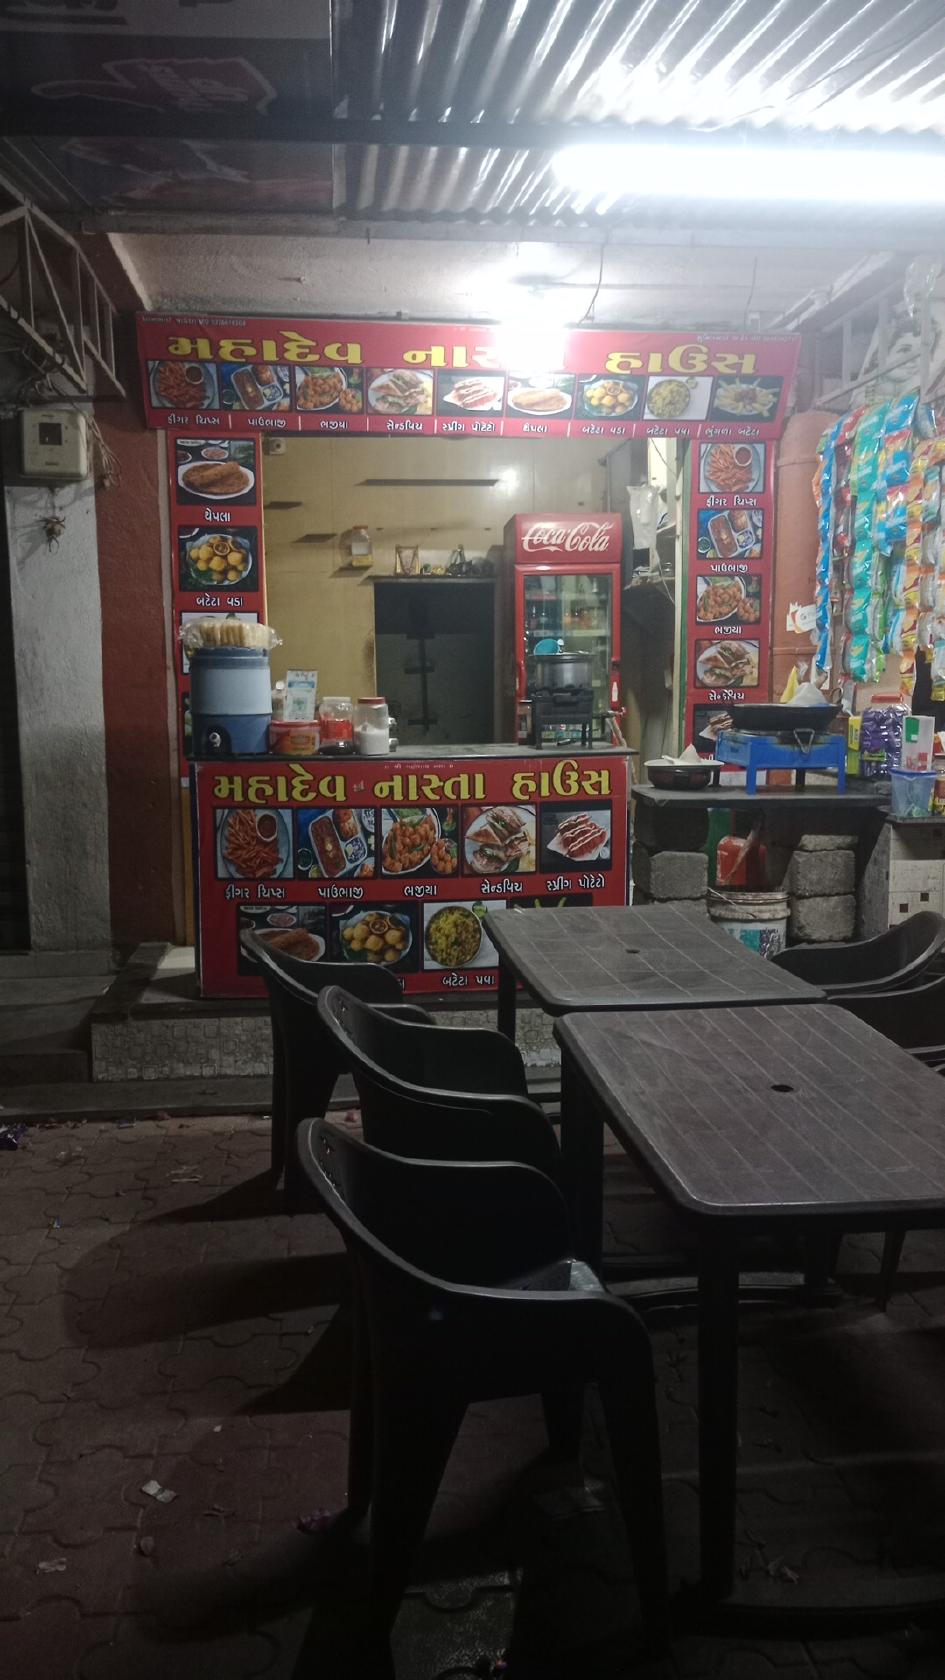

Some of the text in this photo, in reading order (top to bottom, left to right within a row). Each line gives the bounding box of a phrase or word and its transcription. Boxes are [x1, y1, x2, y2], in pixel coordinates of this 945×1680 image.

[168, 331, 363, 364] મહાદેવ
[605, 344, 757, 375] હાઉસ
[204, 507, 231, 522] થેપલા
[196, 592, 243, 607] બટેટા વડા
[213, 760, 612, 804] મહાદેવ નાસ્તા હાઉસ
[404, 885, 437, 898] ભજીયા
[481, 878, 523, 895] સેન્ડવિચ
[442, 972, 468, 987] બટેટા
